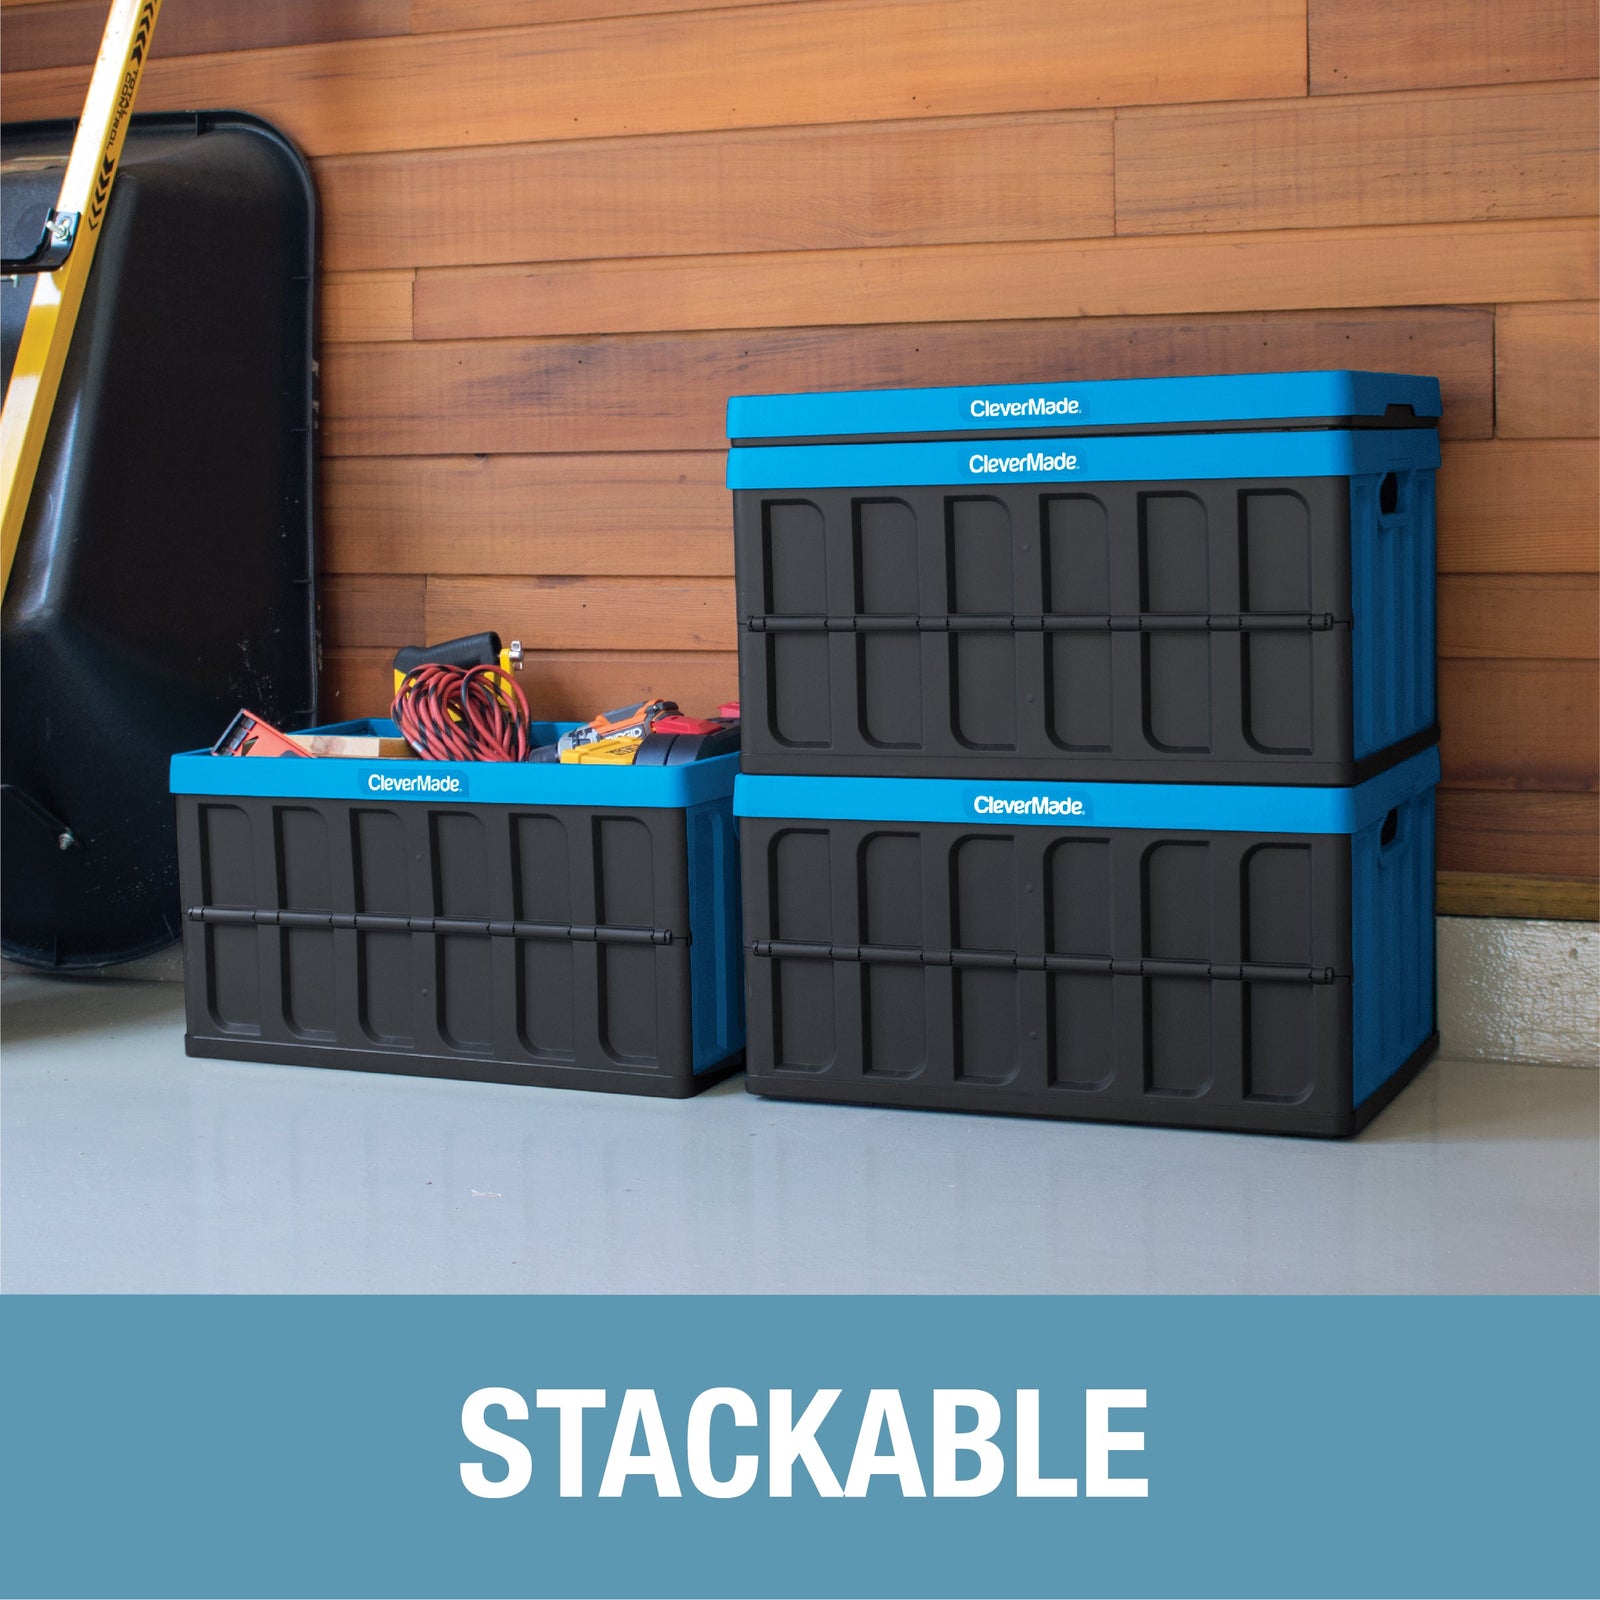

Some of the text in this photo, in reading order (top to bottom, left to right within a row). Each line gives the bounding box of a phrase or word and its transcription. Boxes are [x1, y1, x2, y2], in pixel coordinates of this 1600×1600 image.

[120, 69, 139, 119] TOTAL
[106, 71, 132, 150] CONTROL
[971, 397, 1079, 417] CleverMade
[970, 452, 1077, 474] CleverMade
[368, 773, 461, 792] CleverMade
[974, 795, 1083, 815] CleverMade
